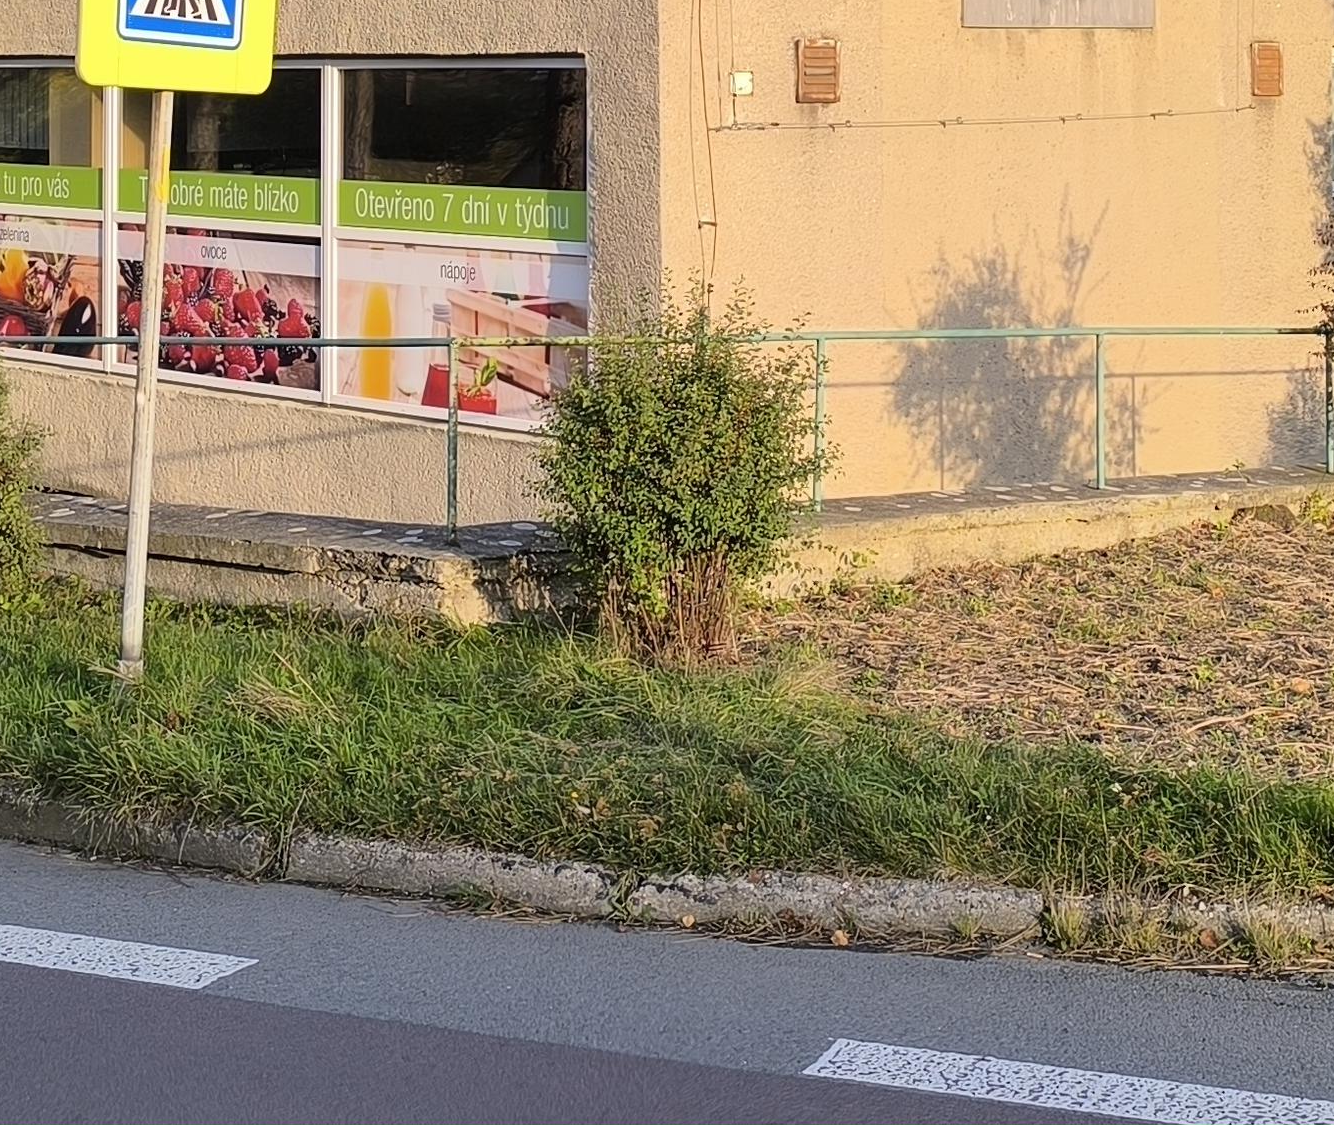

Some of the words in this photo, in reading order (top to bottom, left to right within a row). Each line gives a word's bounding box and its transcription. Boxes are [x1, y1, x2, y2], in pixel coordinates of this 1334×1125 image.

[4, 171, 16, 195] tu
[21, 175, 42, 201] pro
[47, 172, 70, 199] vás
[168, 179, 204, 207] obré
[209, 180, 248, 210] máte
[254, 183, 299, 213] blízko
[355, 188, 434, 222] Otevřeno
[442, 193, 454, 222] 7
[461, 193, 492, 226] dní
[497, 203, 508, 226] v
[515, 196, 570, 234] týdnu
[0, 227, 30, 243] zelenina
[201, 246, 227, 260] ovoce
[440, 261, 476, 284] nápoje
